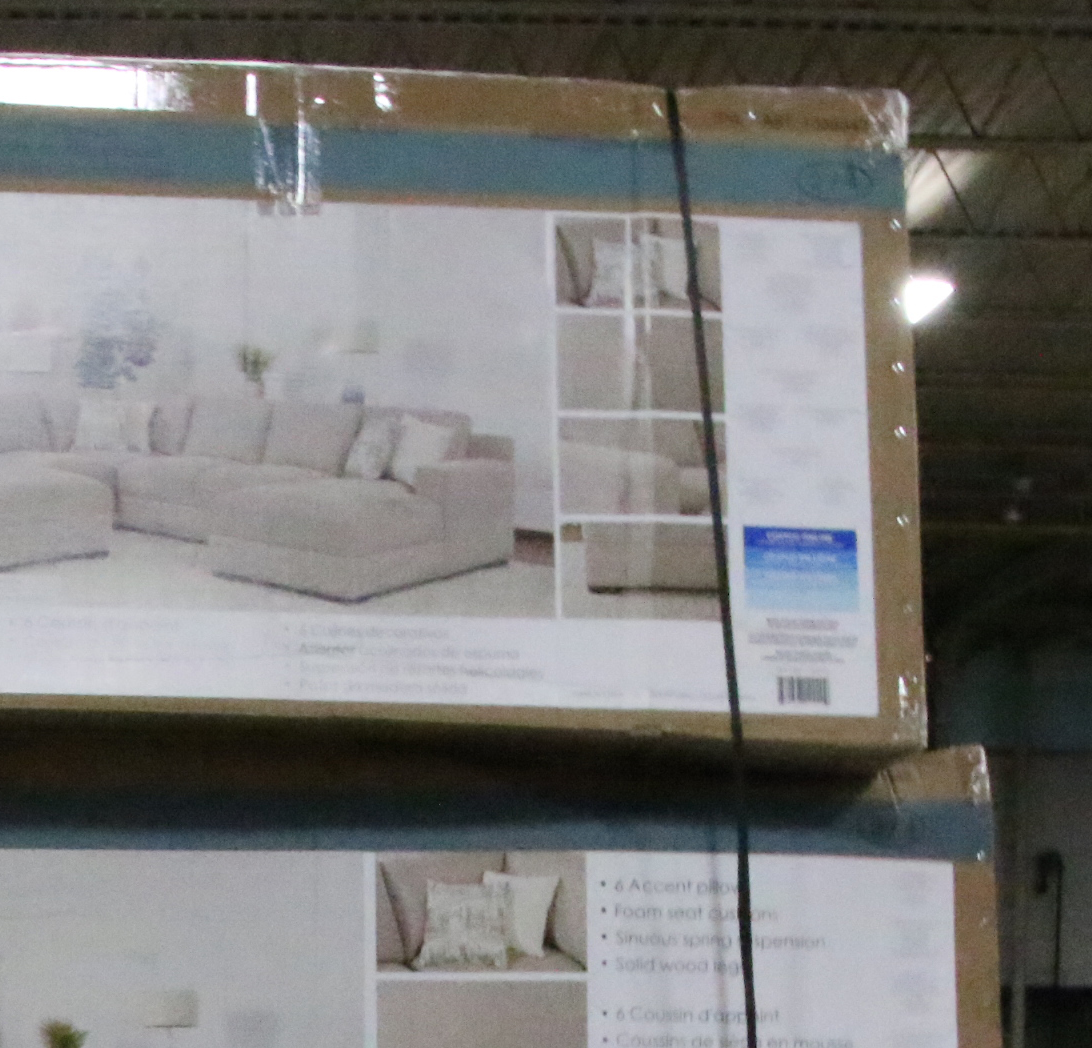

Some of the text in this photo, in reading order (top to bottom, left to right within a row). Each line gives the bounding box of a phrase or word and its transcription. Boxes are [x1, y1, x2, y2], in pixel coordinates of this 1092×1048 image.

[615, 880, 625, 893] 6
[628, 879, 692, 894] Accent
[614, 905, 663, 919] Foam
[667, 906, 703, 920] seat
[616, 931, 678, 946] Sinuous
[683, 933, 732, 952] spring
[616, 957, 656, 972] Solid
[658, 958, 708, 973] wood
[615, 1006, 780, 1028] 6 Coussin d'appint
